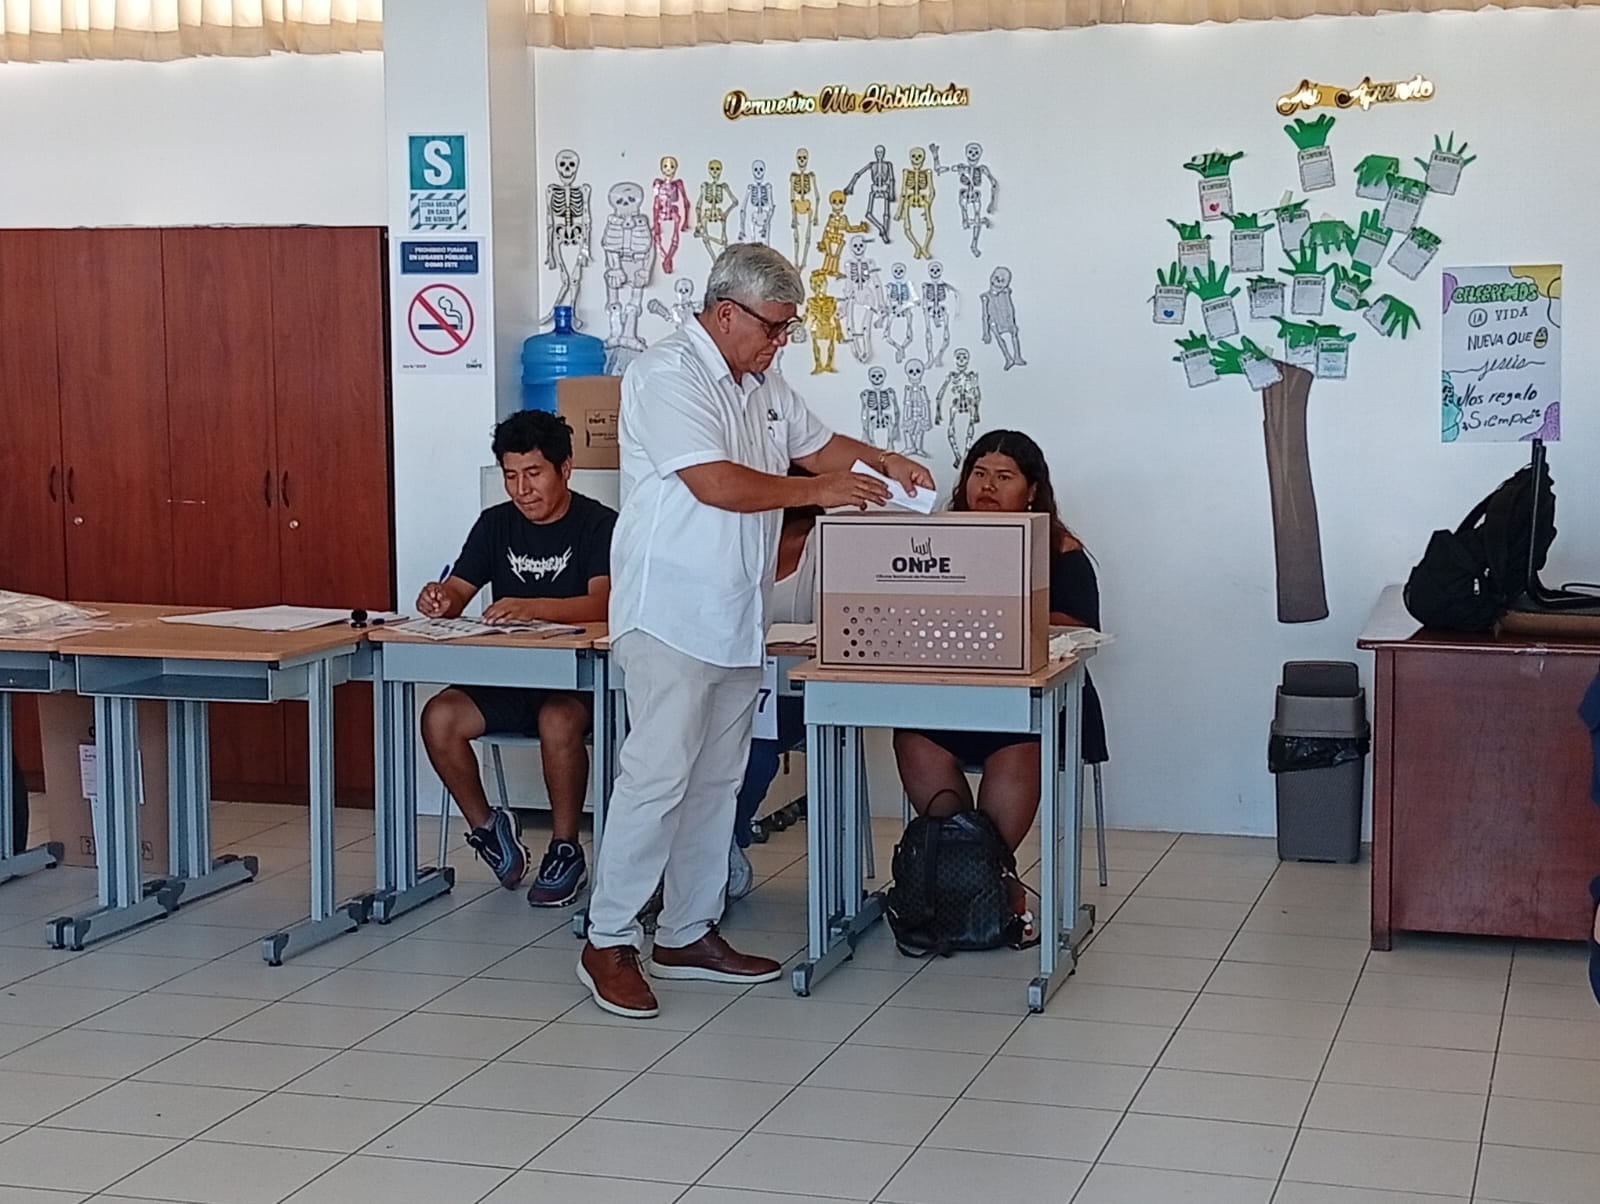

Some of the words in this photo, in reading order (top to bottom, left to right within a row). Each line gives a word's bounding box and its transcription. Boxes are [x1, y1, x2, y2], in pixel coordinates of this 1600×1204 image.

[725, 90, 816, 119] Demuestro
[819, 84, 855, 113] Mis
[862, 83, 968, 112] Habilidades
[423, 140, 452, 186] S
[1495, 306, 1529, 322] VIDA
[1467, 333, 1503, 351] NUEVA
[1507, 331, 1533, 346] QUE
[1488, 384, 1538, 406] regalo
[892, 557, 951, 573] ONPE
